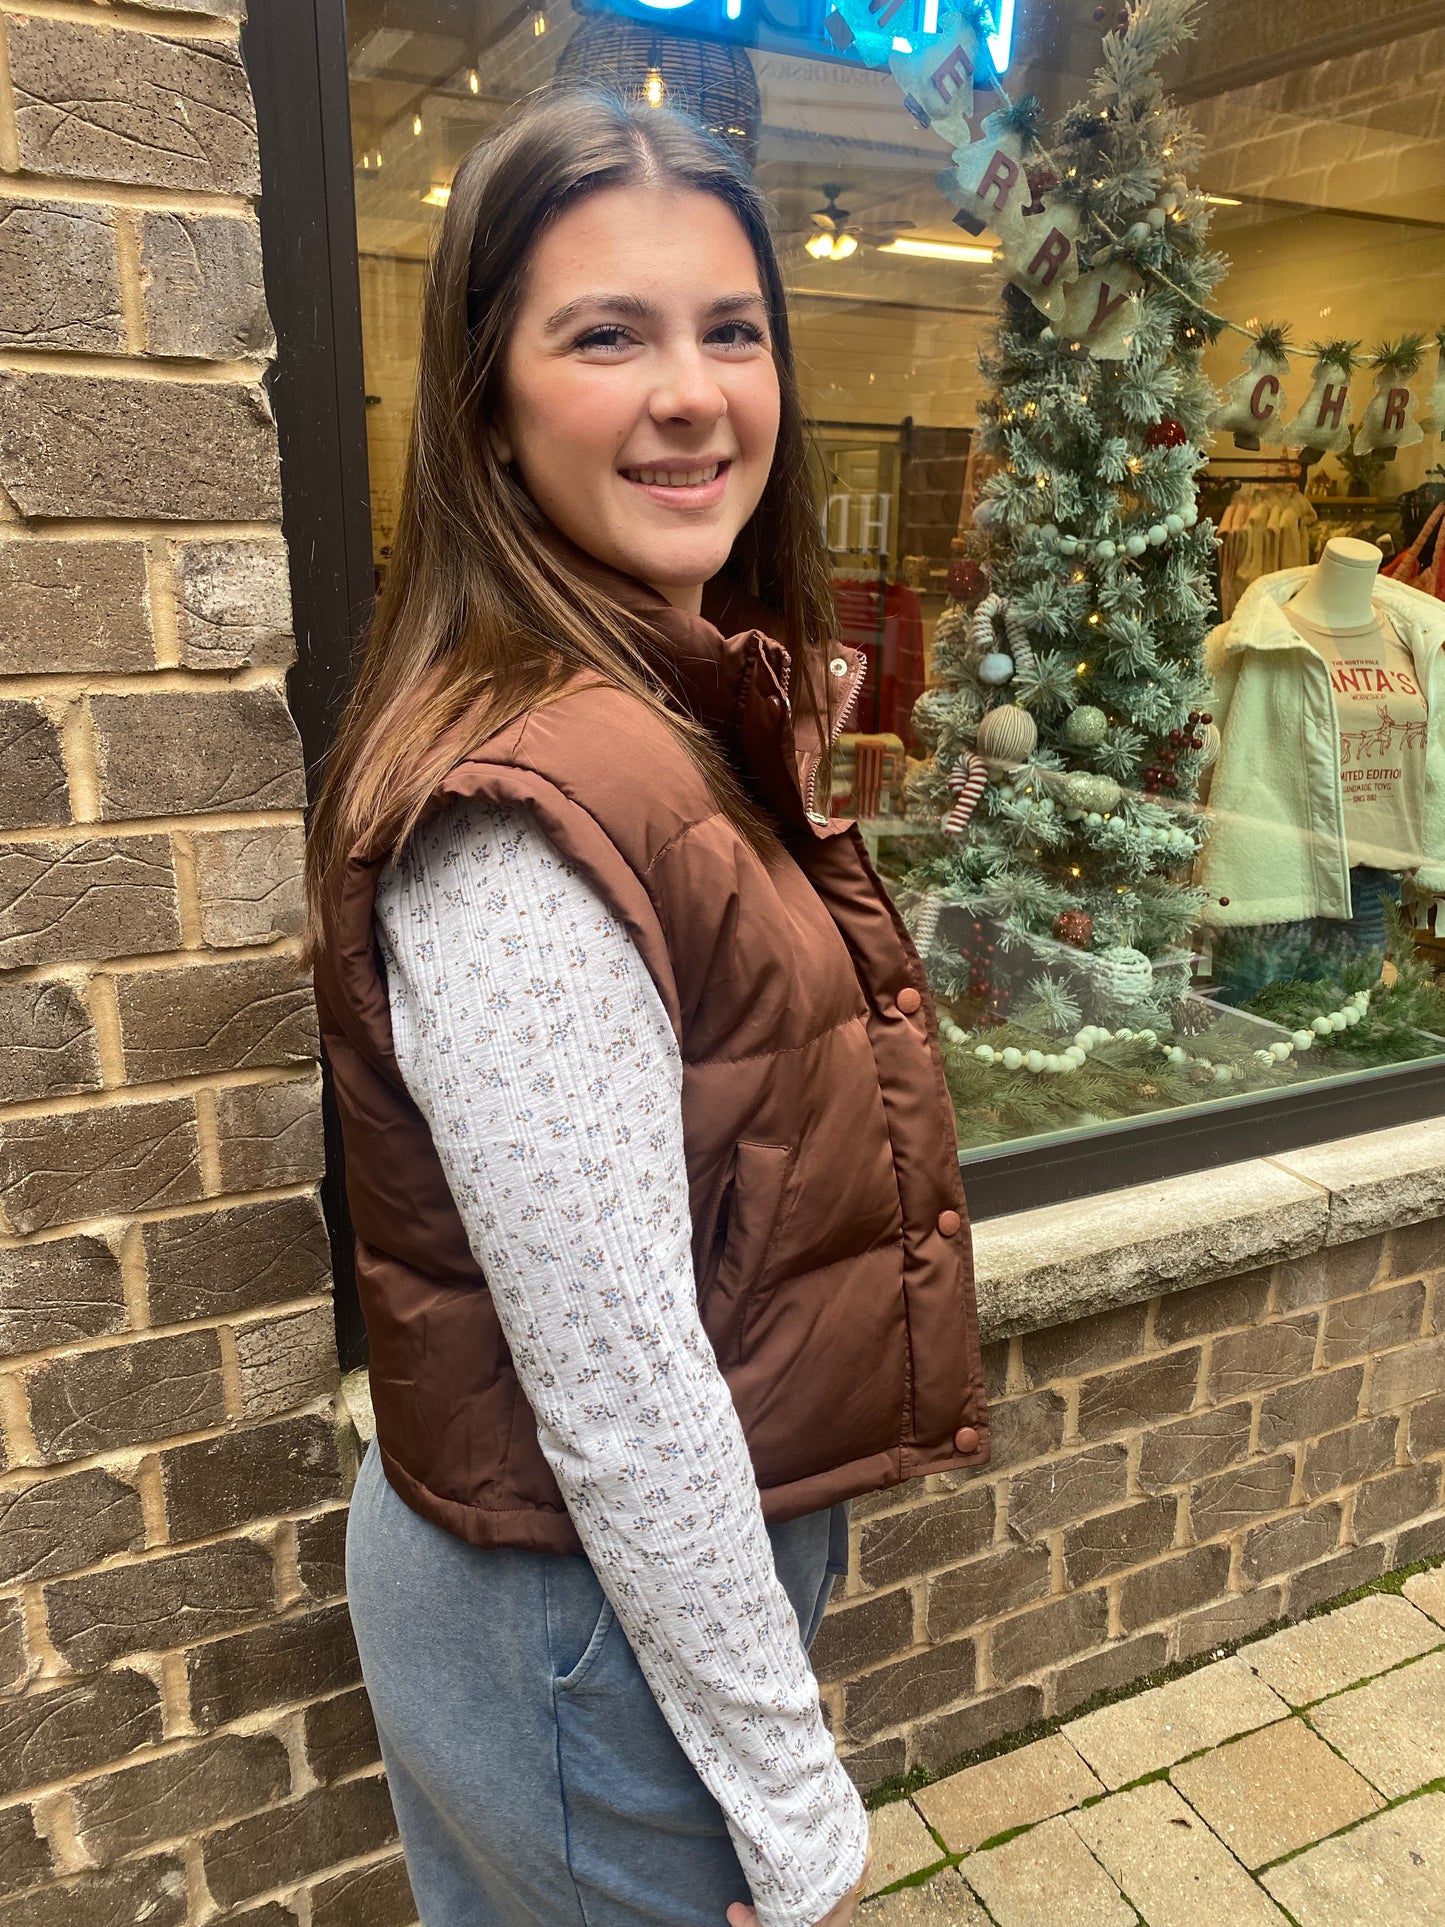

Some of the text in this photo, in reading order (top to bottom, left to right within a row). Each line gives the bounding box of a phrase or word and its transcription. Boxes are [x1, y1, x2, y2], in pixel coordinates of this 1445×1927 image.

[1250, 374, 1410, 431] CHR
[1330, 668, 1417, 695] ANTA'S
[1374, 782, 1392, 791] TOYS
